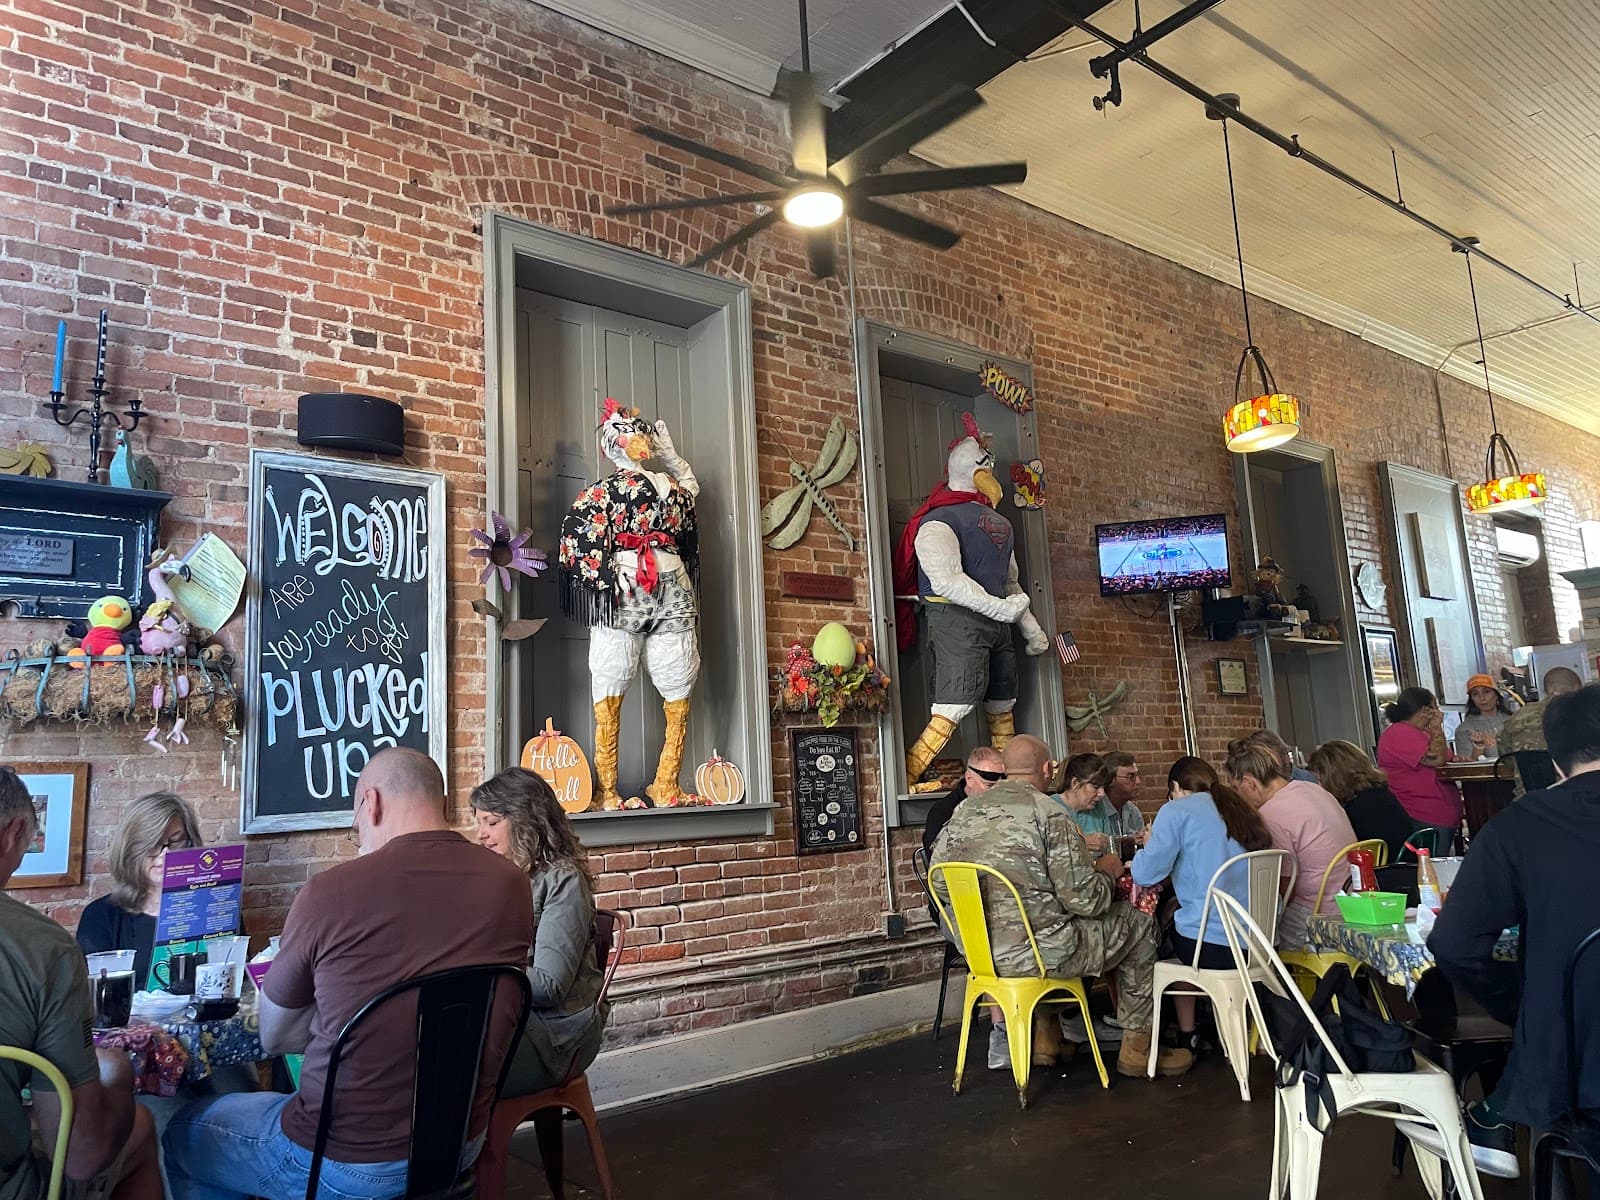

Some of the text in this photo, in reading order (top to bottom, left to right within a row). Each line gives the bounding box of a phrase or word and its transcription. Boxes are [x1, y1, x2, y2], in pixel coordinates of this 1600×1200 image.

[986, 367, 1026, 408] POW!
[27, 538, 61, 549] LORD
[303, 579, 398, 663] ready
[346, 627, 379, 652] to
[530, 743, 579, 771] Hello
